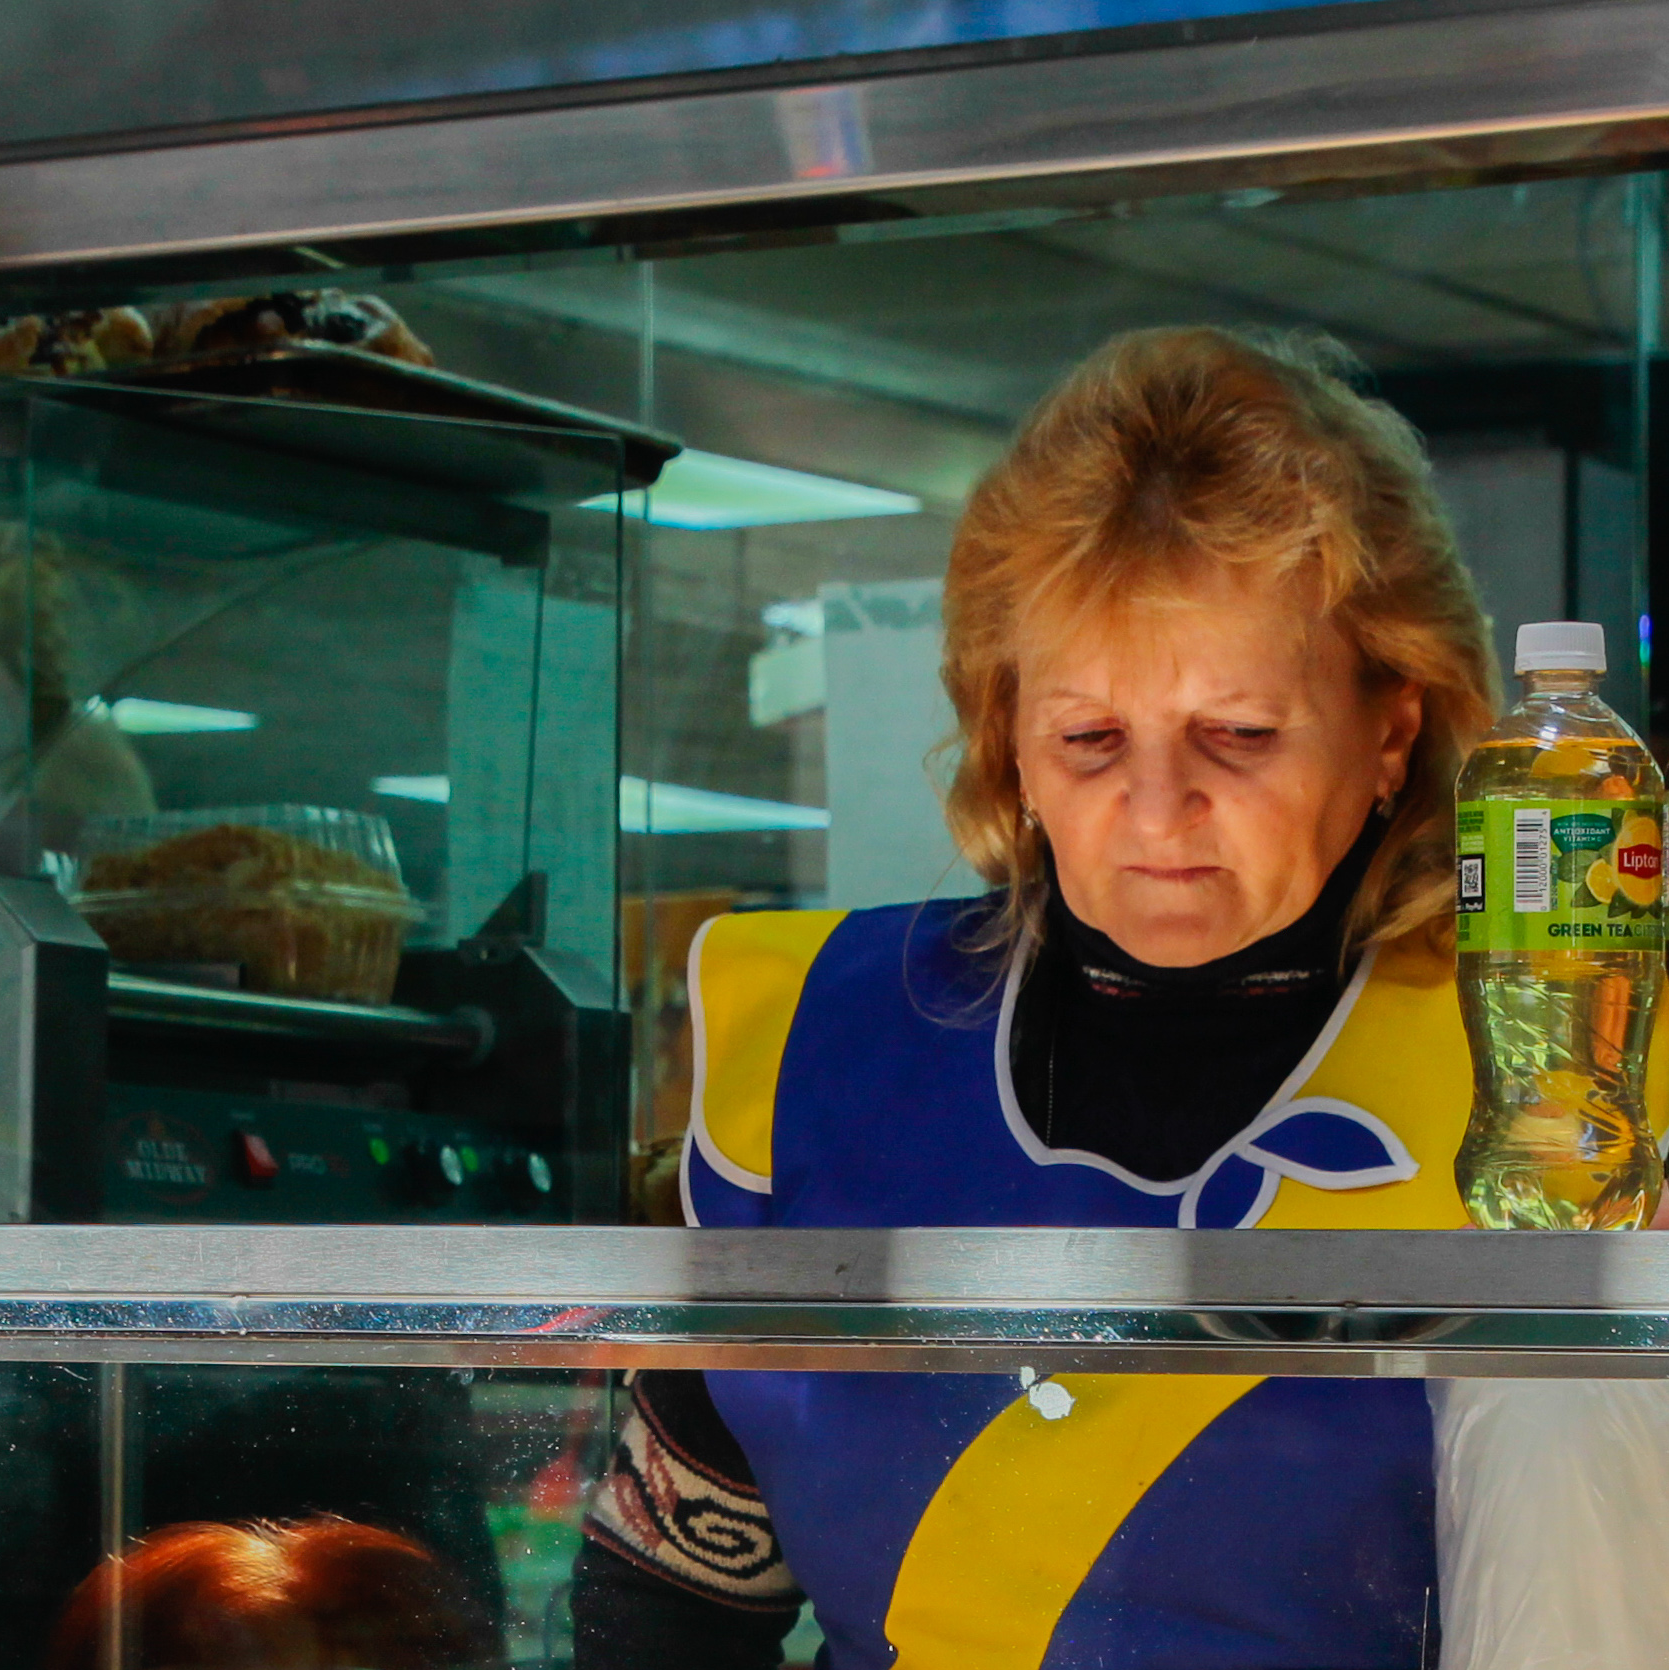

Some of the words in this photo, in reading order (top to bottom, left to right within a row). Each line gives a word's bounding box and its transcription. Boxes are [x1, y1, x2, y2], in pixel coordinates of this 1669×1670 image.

[1624, 851, 1658, 870] Lipton
[1548, 923, 1602, 937] GREEN
[1607, 924, 1632, 937] TEA
